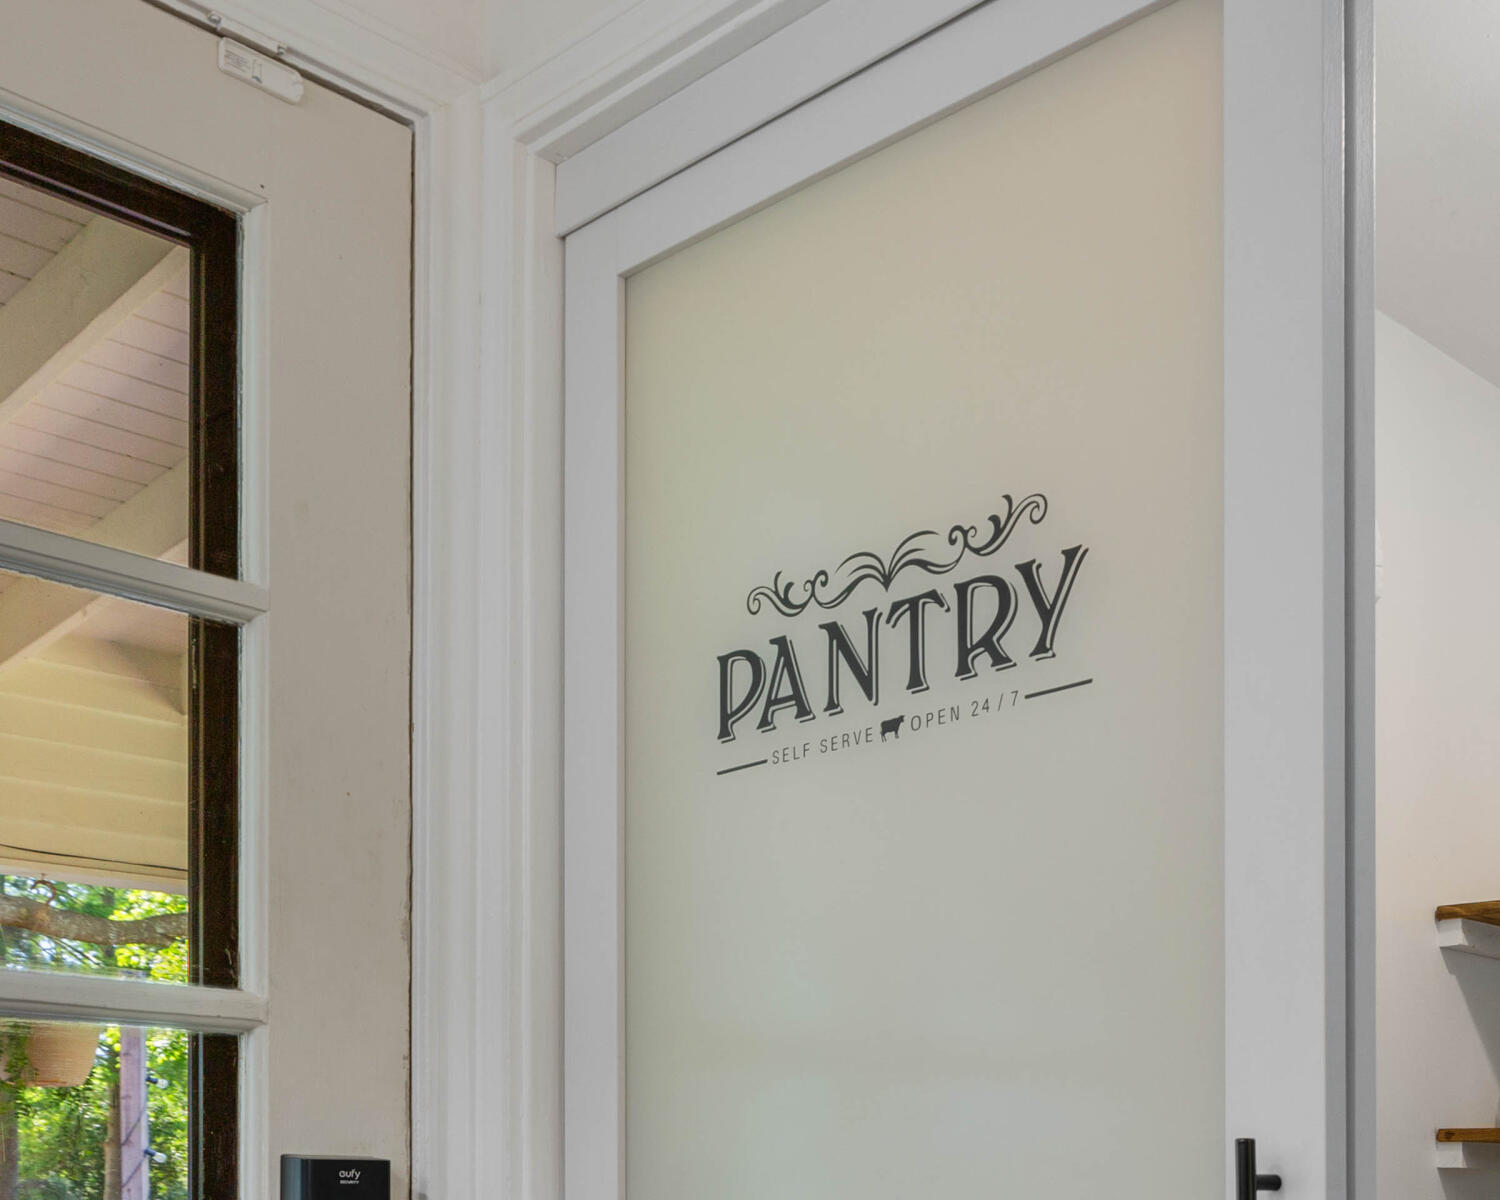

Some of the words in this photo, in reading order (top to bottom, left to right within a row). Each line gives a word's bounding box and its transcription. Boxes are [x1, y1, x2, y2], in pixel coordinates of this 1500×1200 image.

[717, 544, 1089, 744] PANTRY
[772, 743, 811, 765] SELF
[820, 727, 873, 754] SERVE
[910, 705, 960, 732] OPEN
[339, 1169, 361, 1180] eufy
